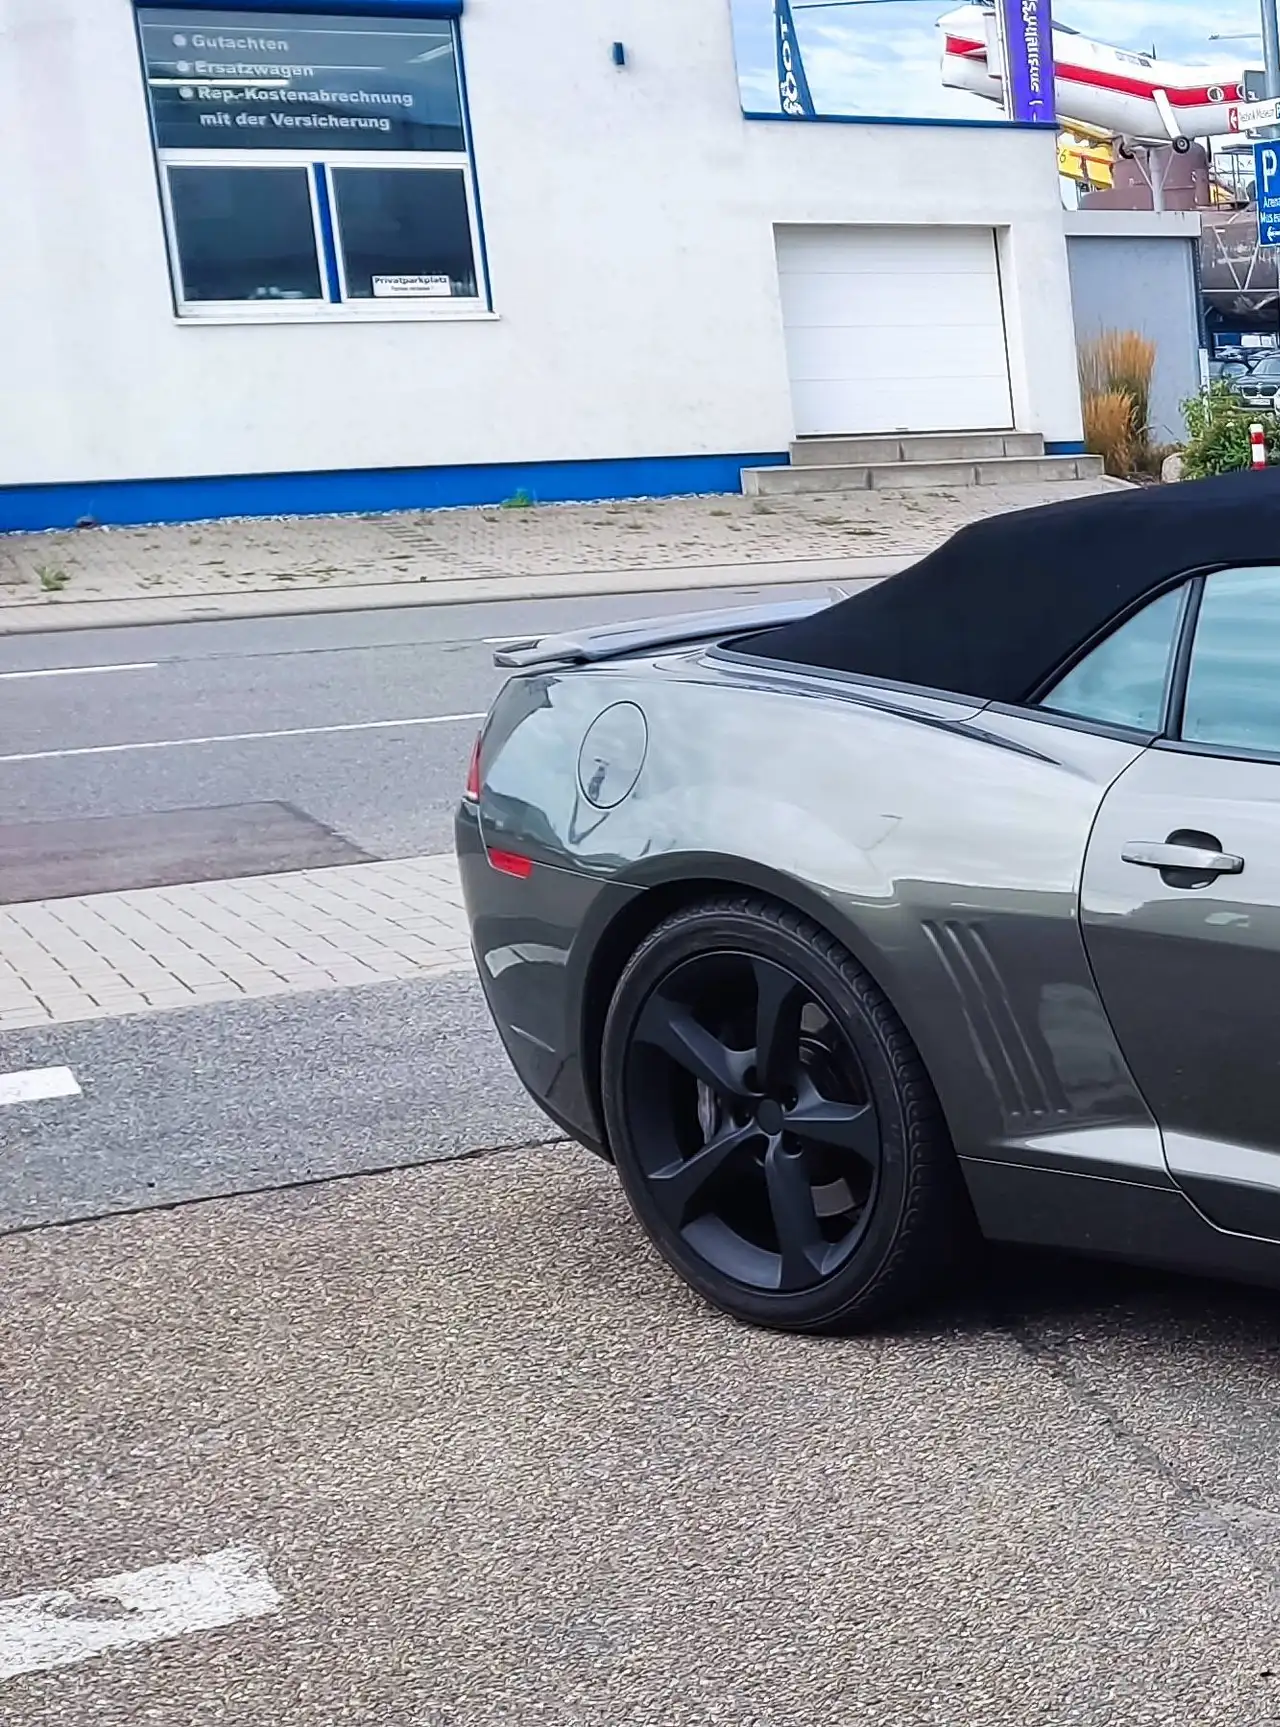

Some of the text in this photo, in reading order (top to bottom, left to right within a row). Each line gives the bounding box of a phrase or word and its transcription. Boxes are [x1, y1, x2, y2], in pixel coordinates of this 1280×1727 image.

[192, 35, 290, 51] Gutachten
[194, 61, 314, 78] Ersatzwagen
[198, 86, 413, 107] Rep.-Kostenabrechnung
[200, 113, 391, 131] mit der Versicherung
[1261, 149, 1277, 193] P
